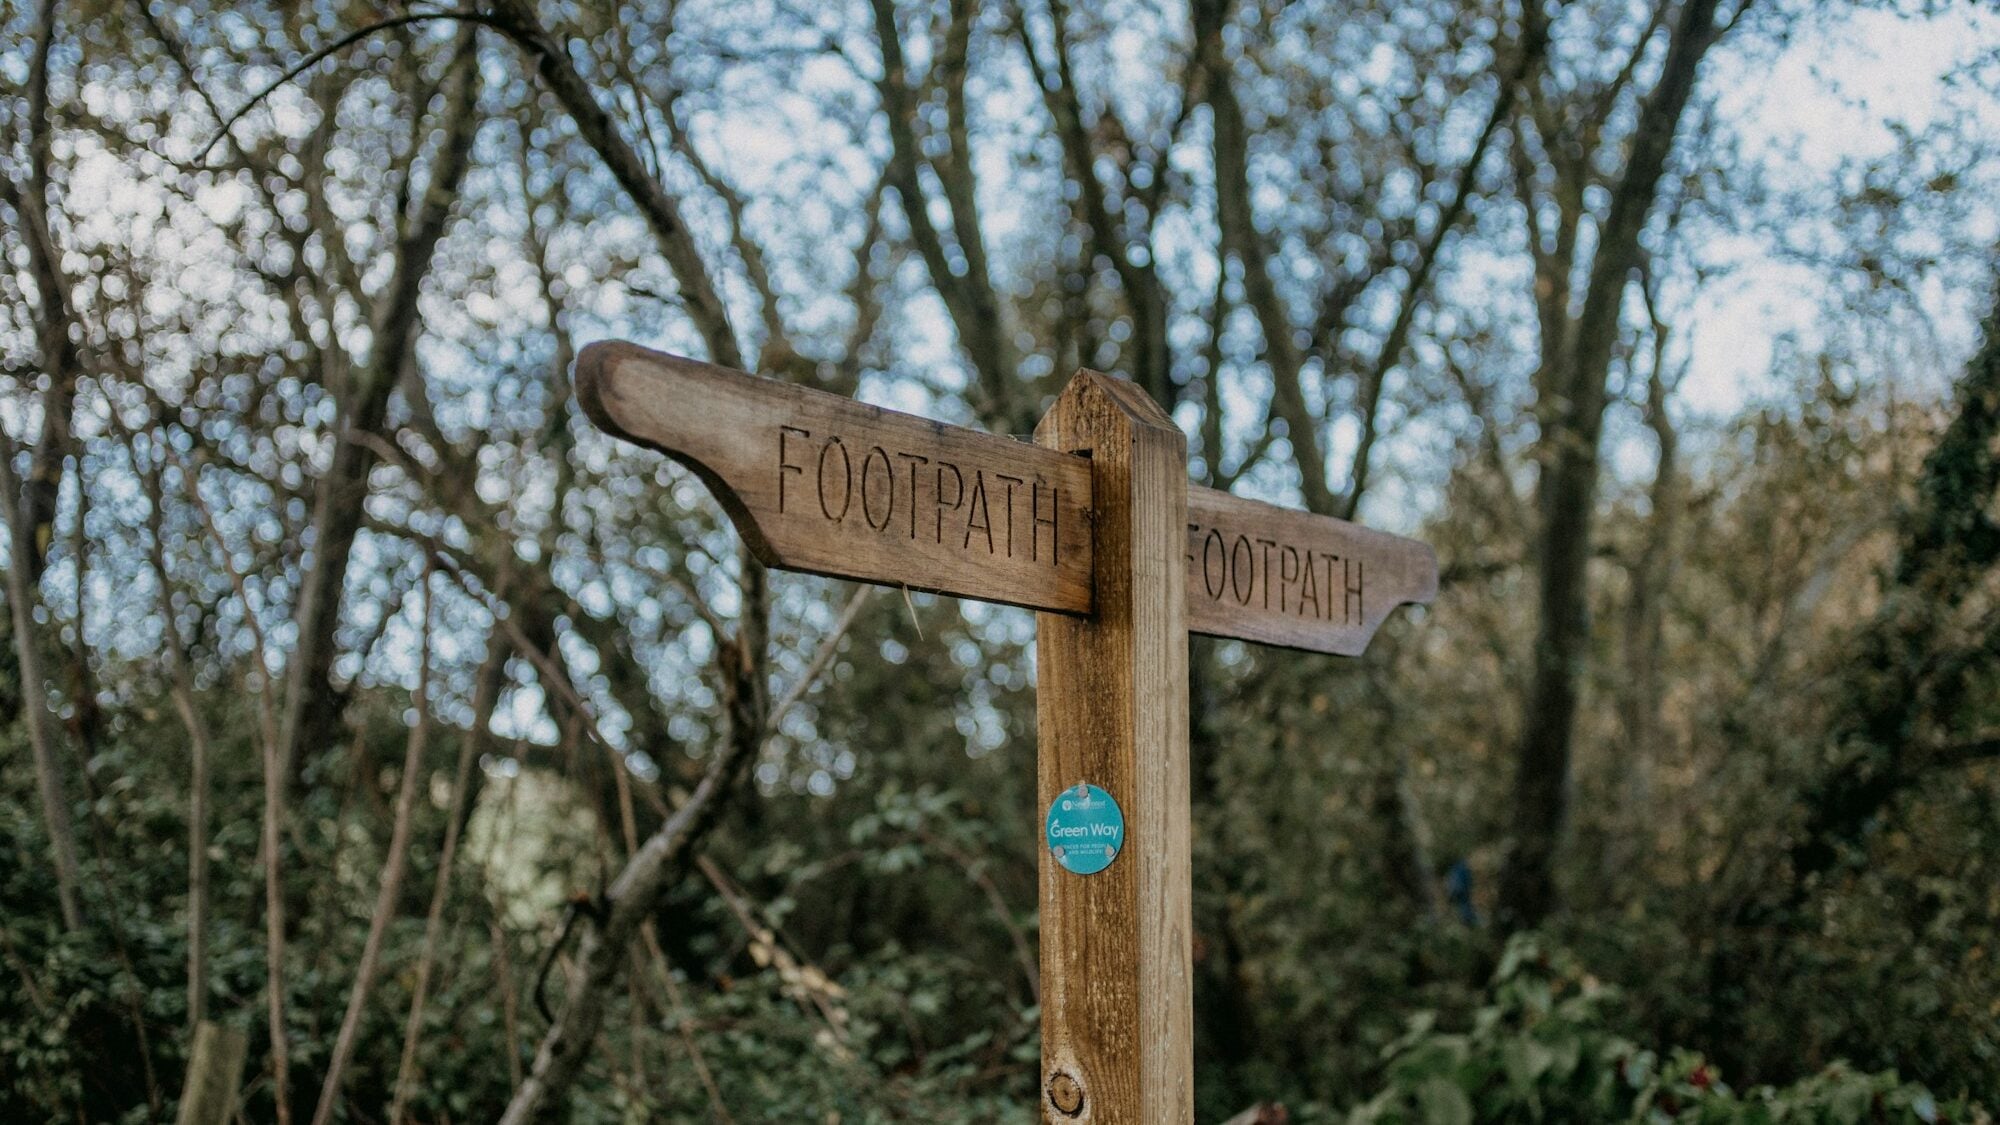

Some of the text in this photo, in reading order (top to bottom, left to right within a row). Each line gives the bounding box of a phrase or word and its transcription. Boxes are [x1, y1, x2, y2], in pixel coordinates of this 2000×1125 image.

[779, 425, 1058, 566] FOOTPATH
[1050, 822, 1119, 840] Green Way
